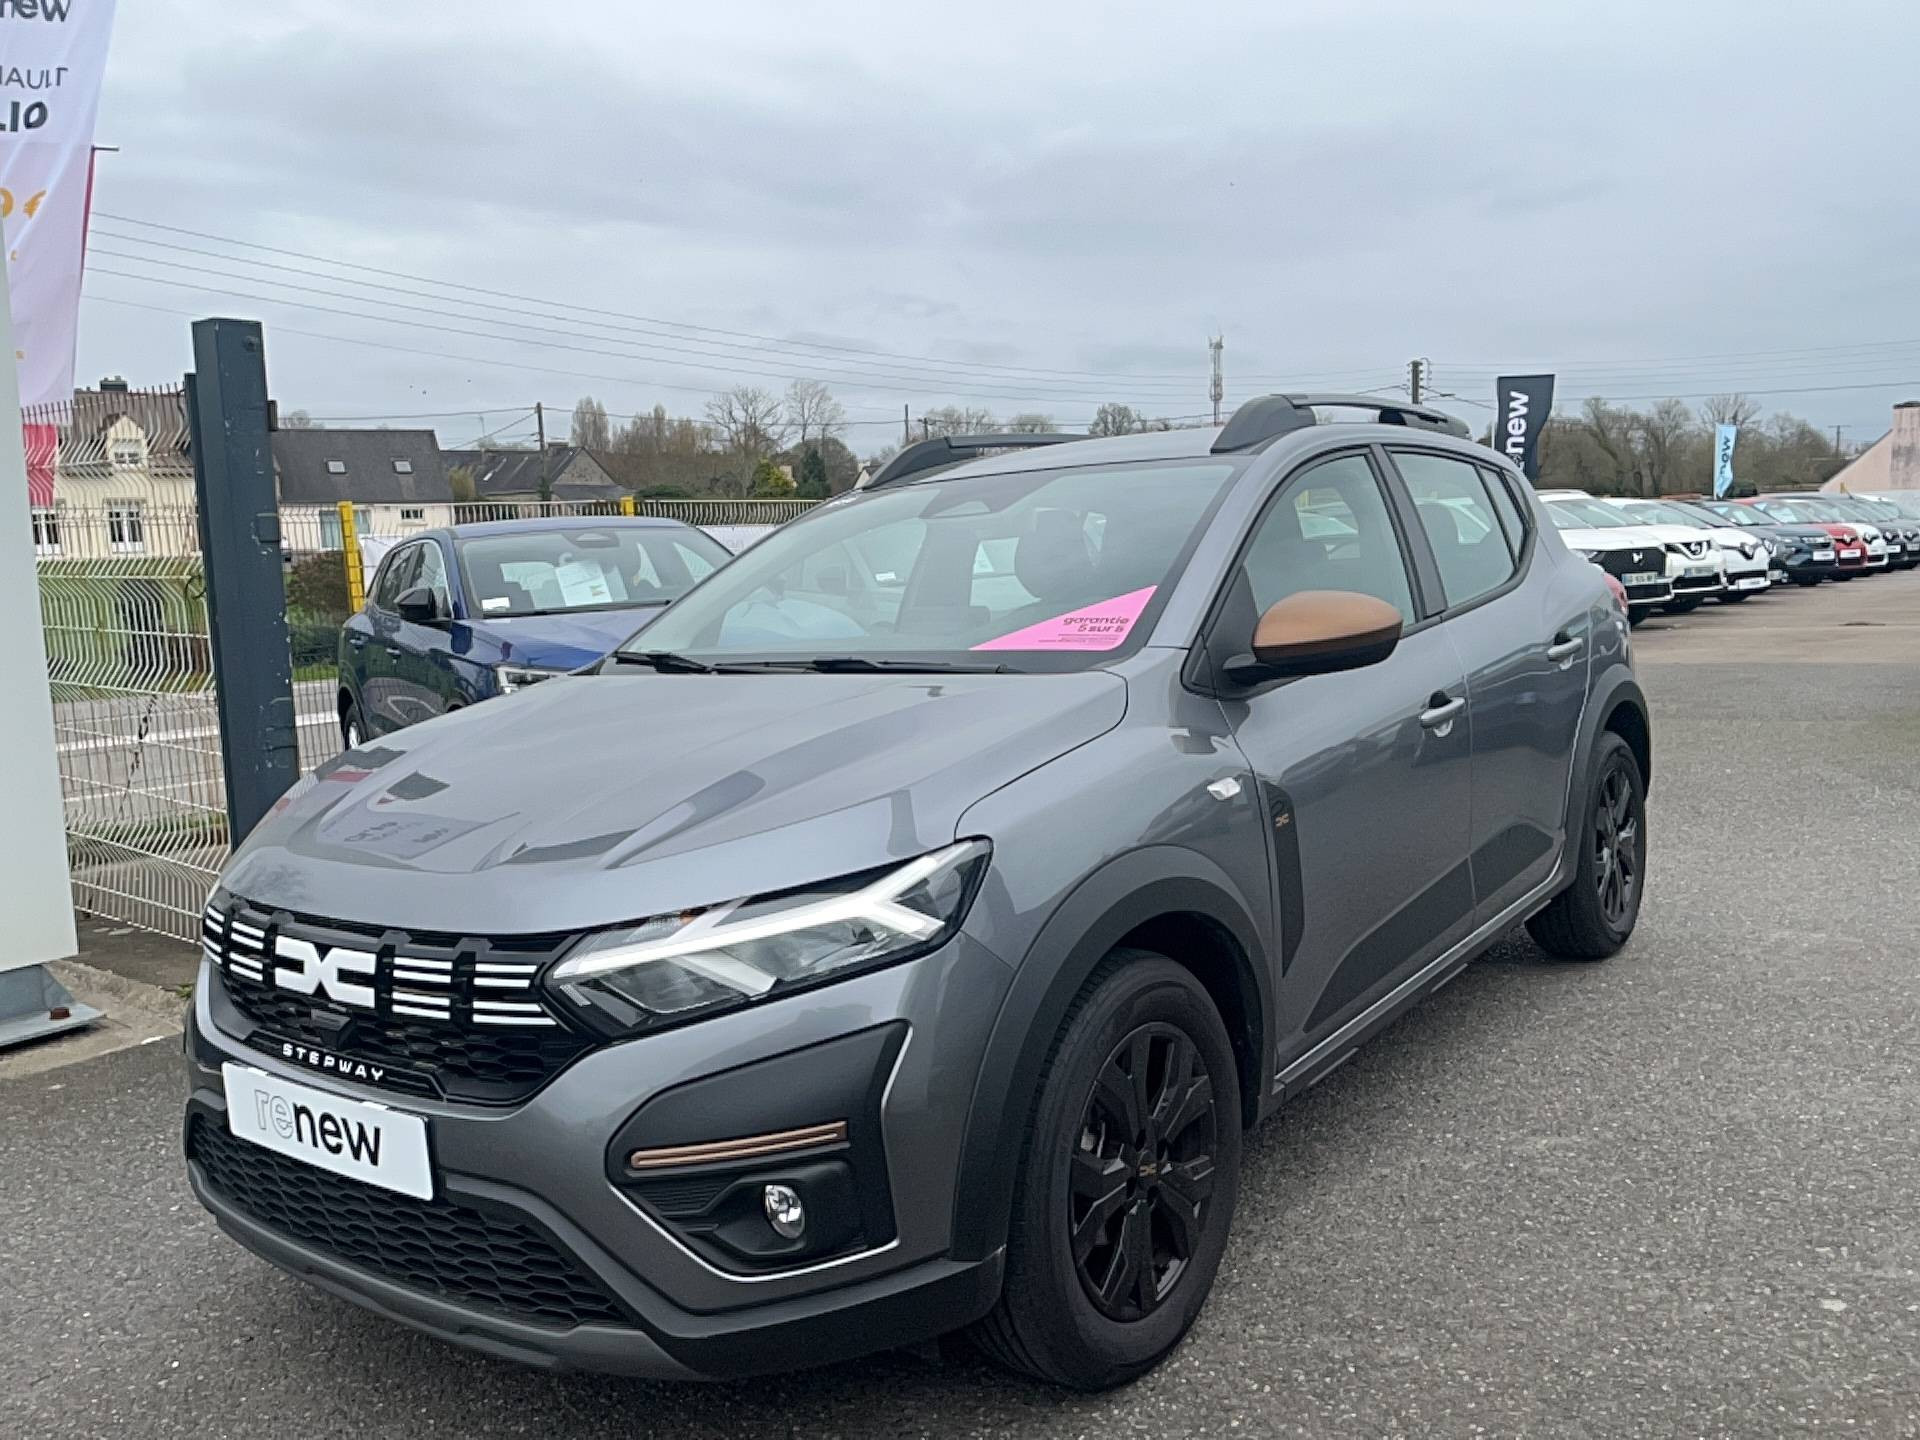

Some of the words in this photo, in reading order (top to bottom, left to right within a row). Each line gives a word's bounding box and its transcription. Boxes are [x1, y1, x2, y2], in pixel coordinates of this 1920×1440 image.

[0, 65, 69, 90] AULT
[282, 1043, 384, 1081] STEPWAY
[253, 1088, 382, 1167] renew
